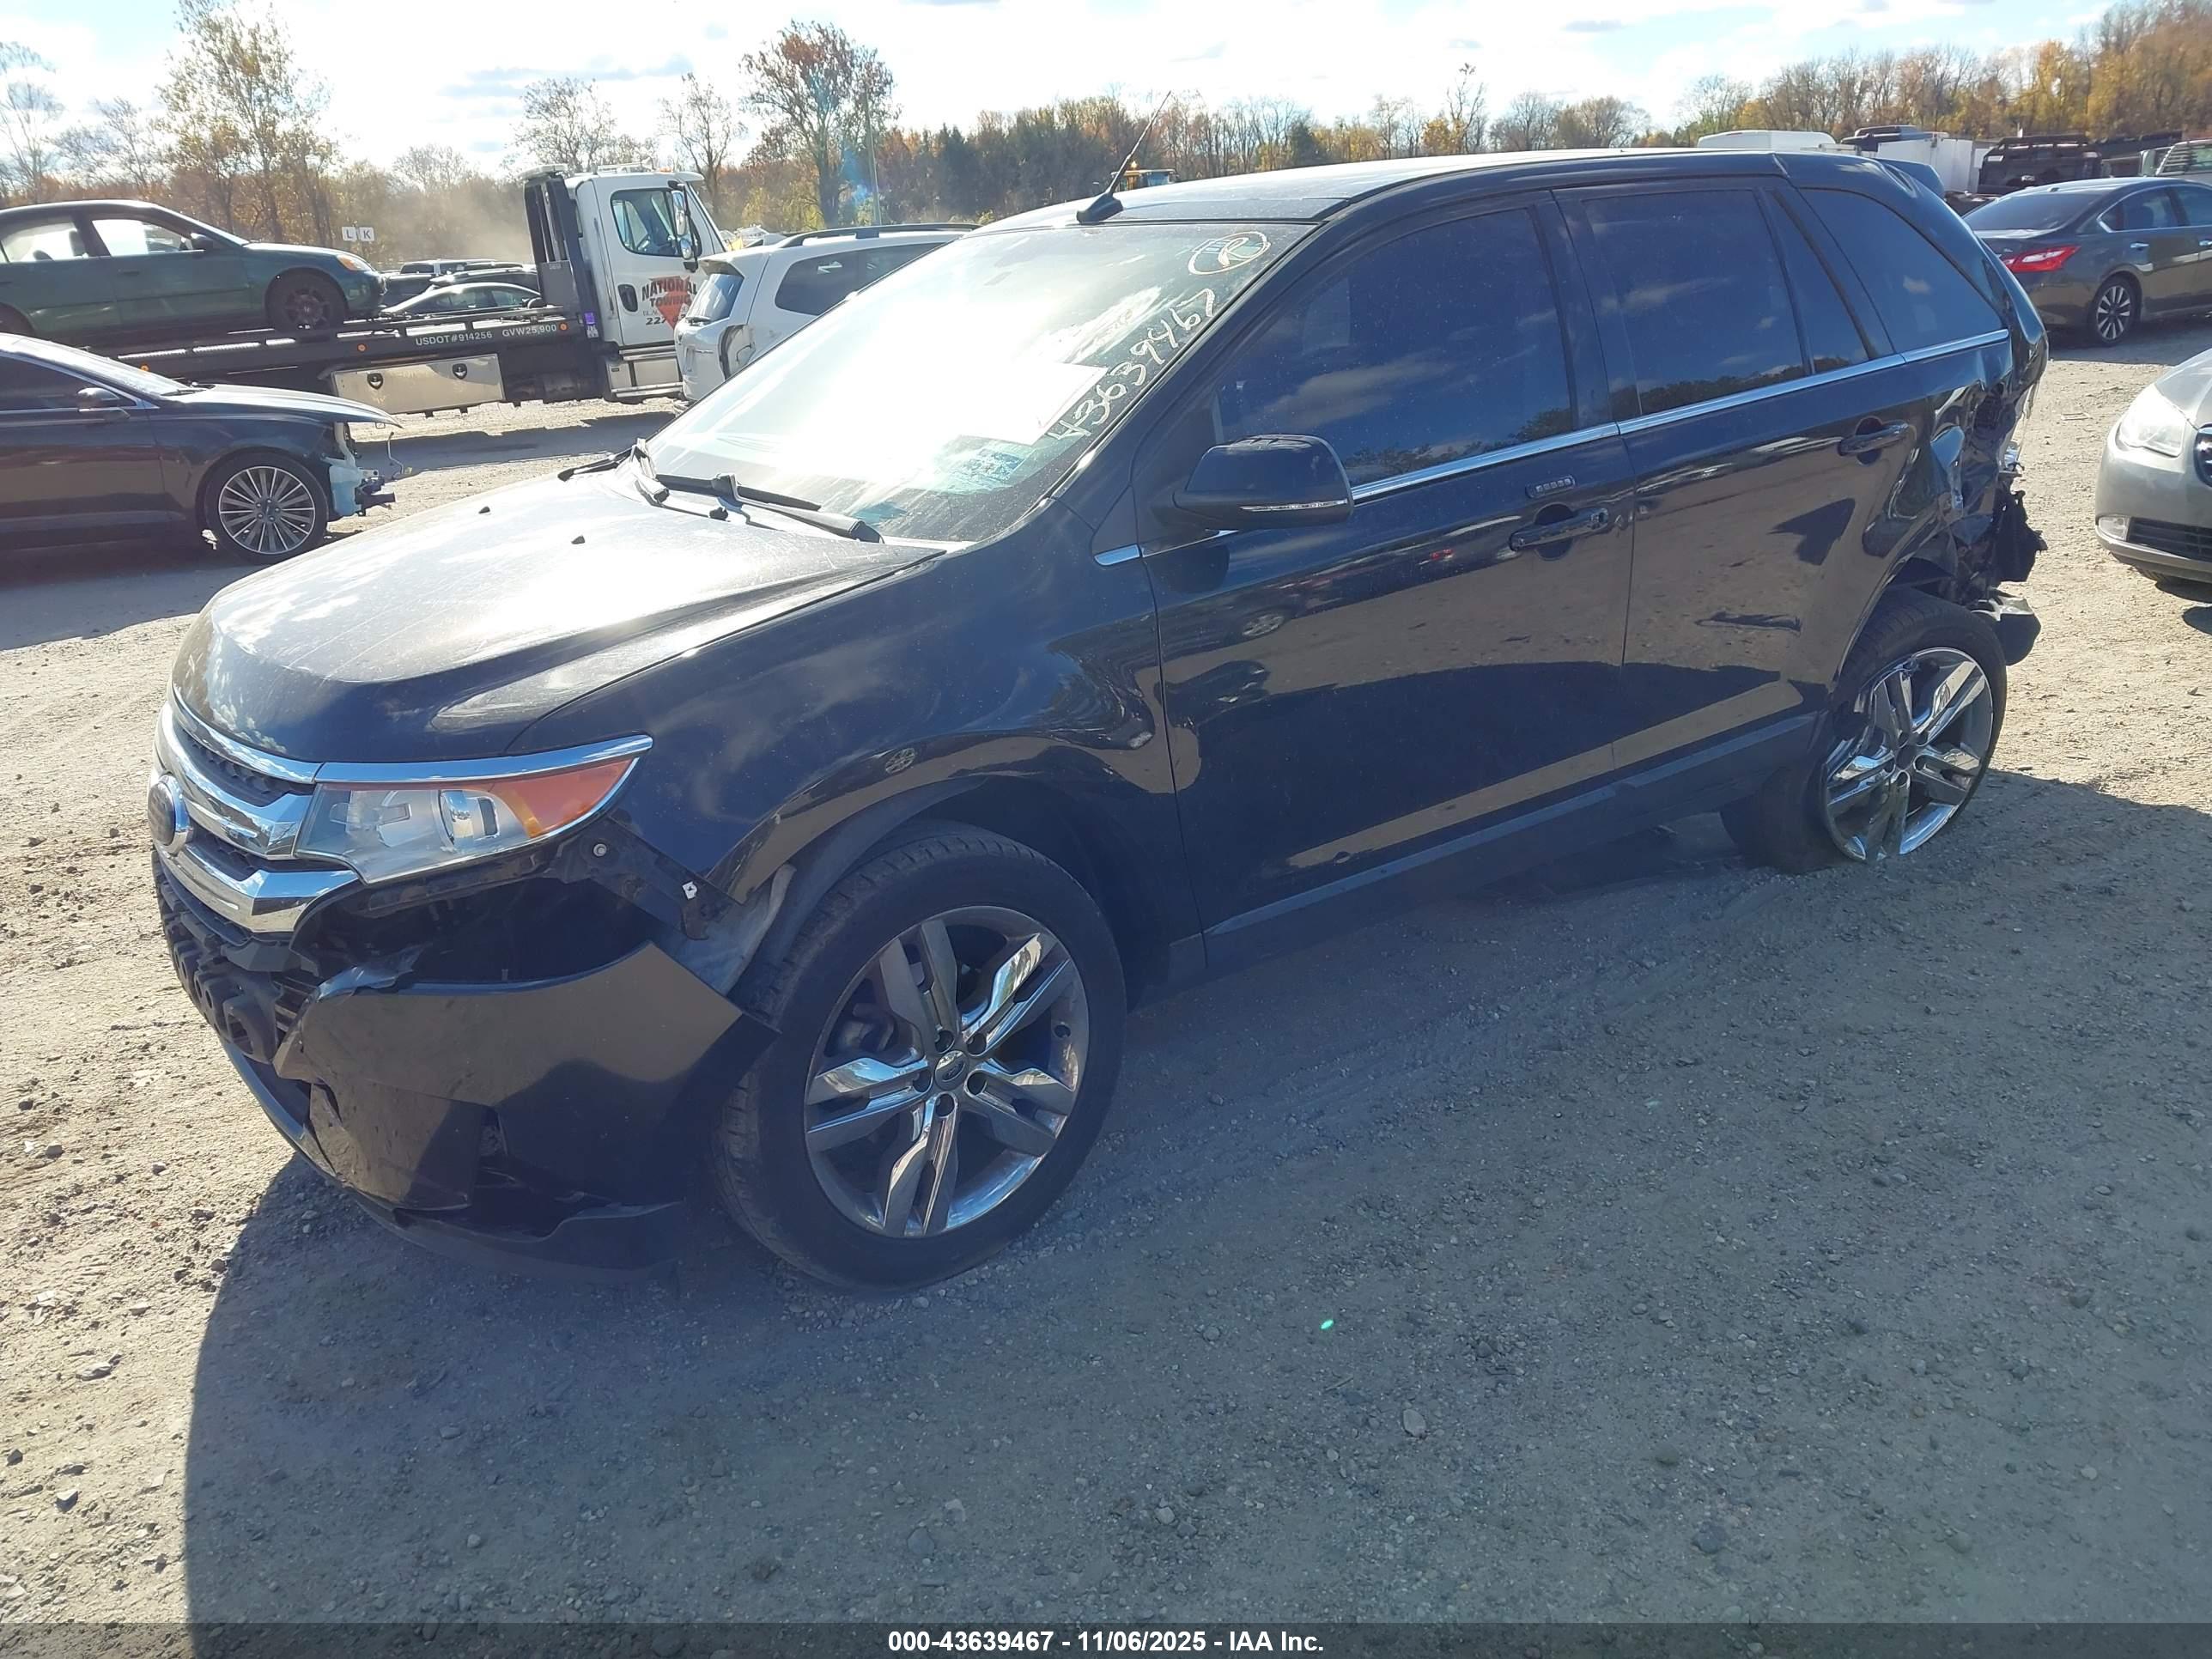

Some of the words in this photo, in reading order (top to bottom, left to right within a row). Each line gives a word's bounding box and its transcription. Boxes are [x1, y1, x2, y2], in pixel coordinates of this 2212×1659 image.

[363, 230, 371, 240] K
[641, 277, 697, 301] NATIONAL
[649, 294, 693, 307] TOWING
[415, 331, 493, 346] USDOT#914256
[501, 324, 557, 337] GVW25,900
[1044, 288, 1216, 440] 43639467
